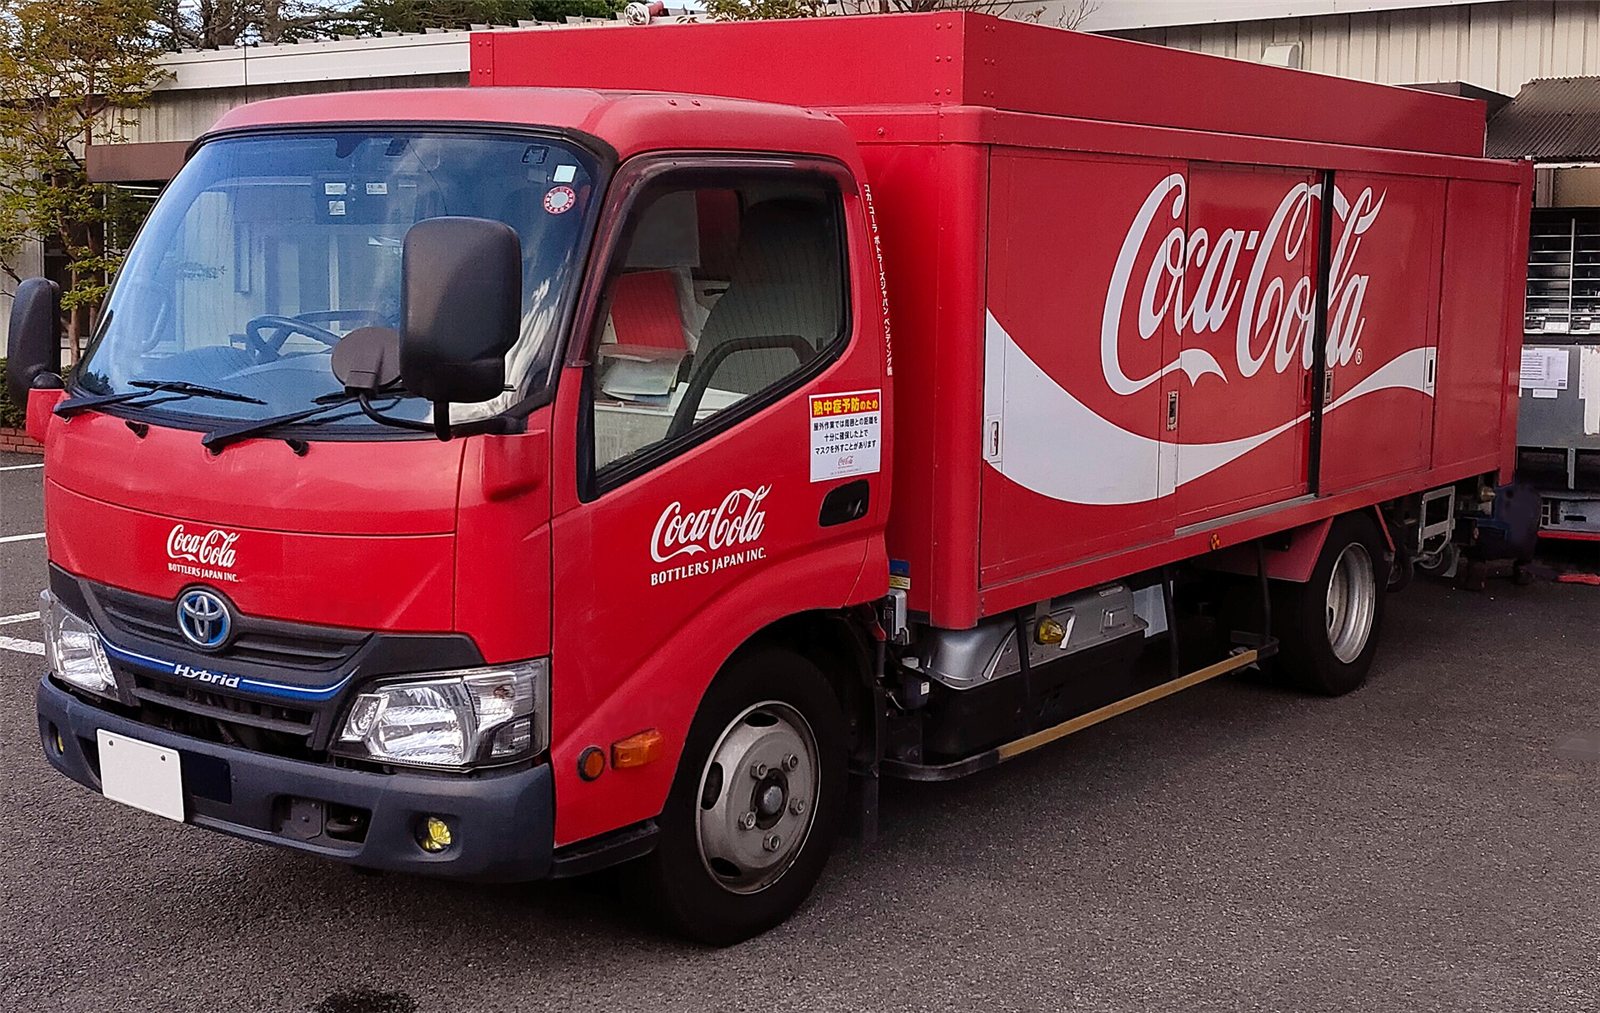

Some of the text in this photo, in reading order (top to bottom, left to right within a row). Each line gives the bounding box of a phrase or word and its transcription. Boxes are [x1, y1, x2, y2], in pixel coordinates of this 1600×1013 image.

[863, 183, 878, 233] コカ・コーラ
[873, 235, 889, 315] ボトラーズジャパン
[813, 397, 878, 415] 熱中症予防のため
[815, 440, 877, 455] マスクを外すことがあります
[824, 429, 869, 442] 十分に確保した上で
[650, 483, 773, 563] Coca-Cola
[166, 524, 241, 568] Coca-Cola
[167, 562, 201, 577] BOTTLERS
[201, 568, 223, 580] JAPAN
[650, 547, 767, 586] BOTTLERS JAPAN INC.
[174, 664, 240, 688] Hybrid
